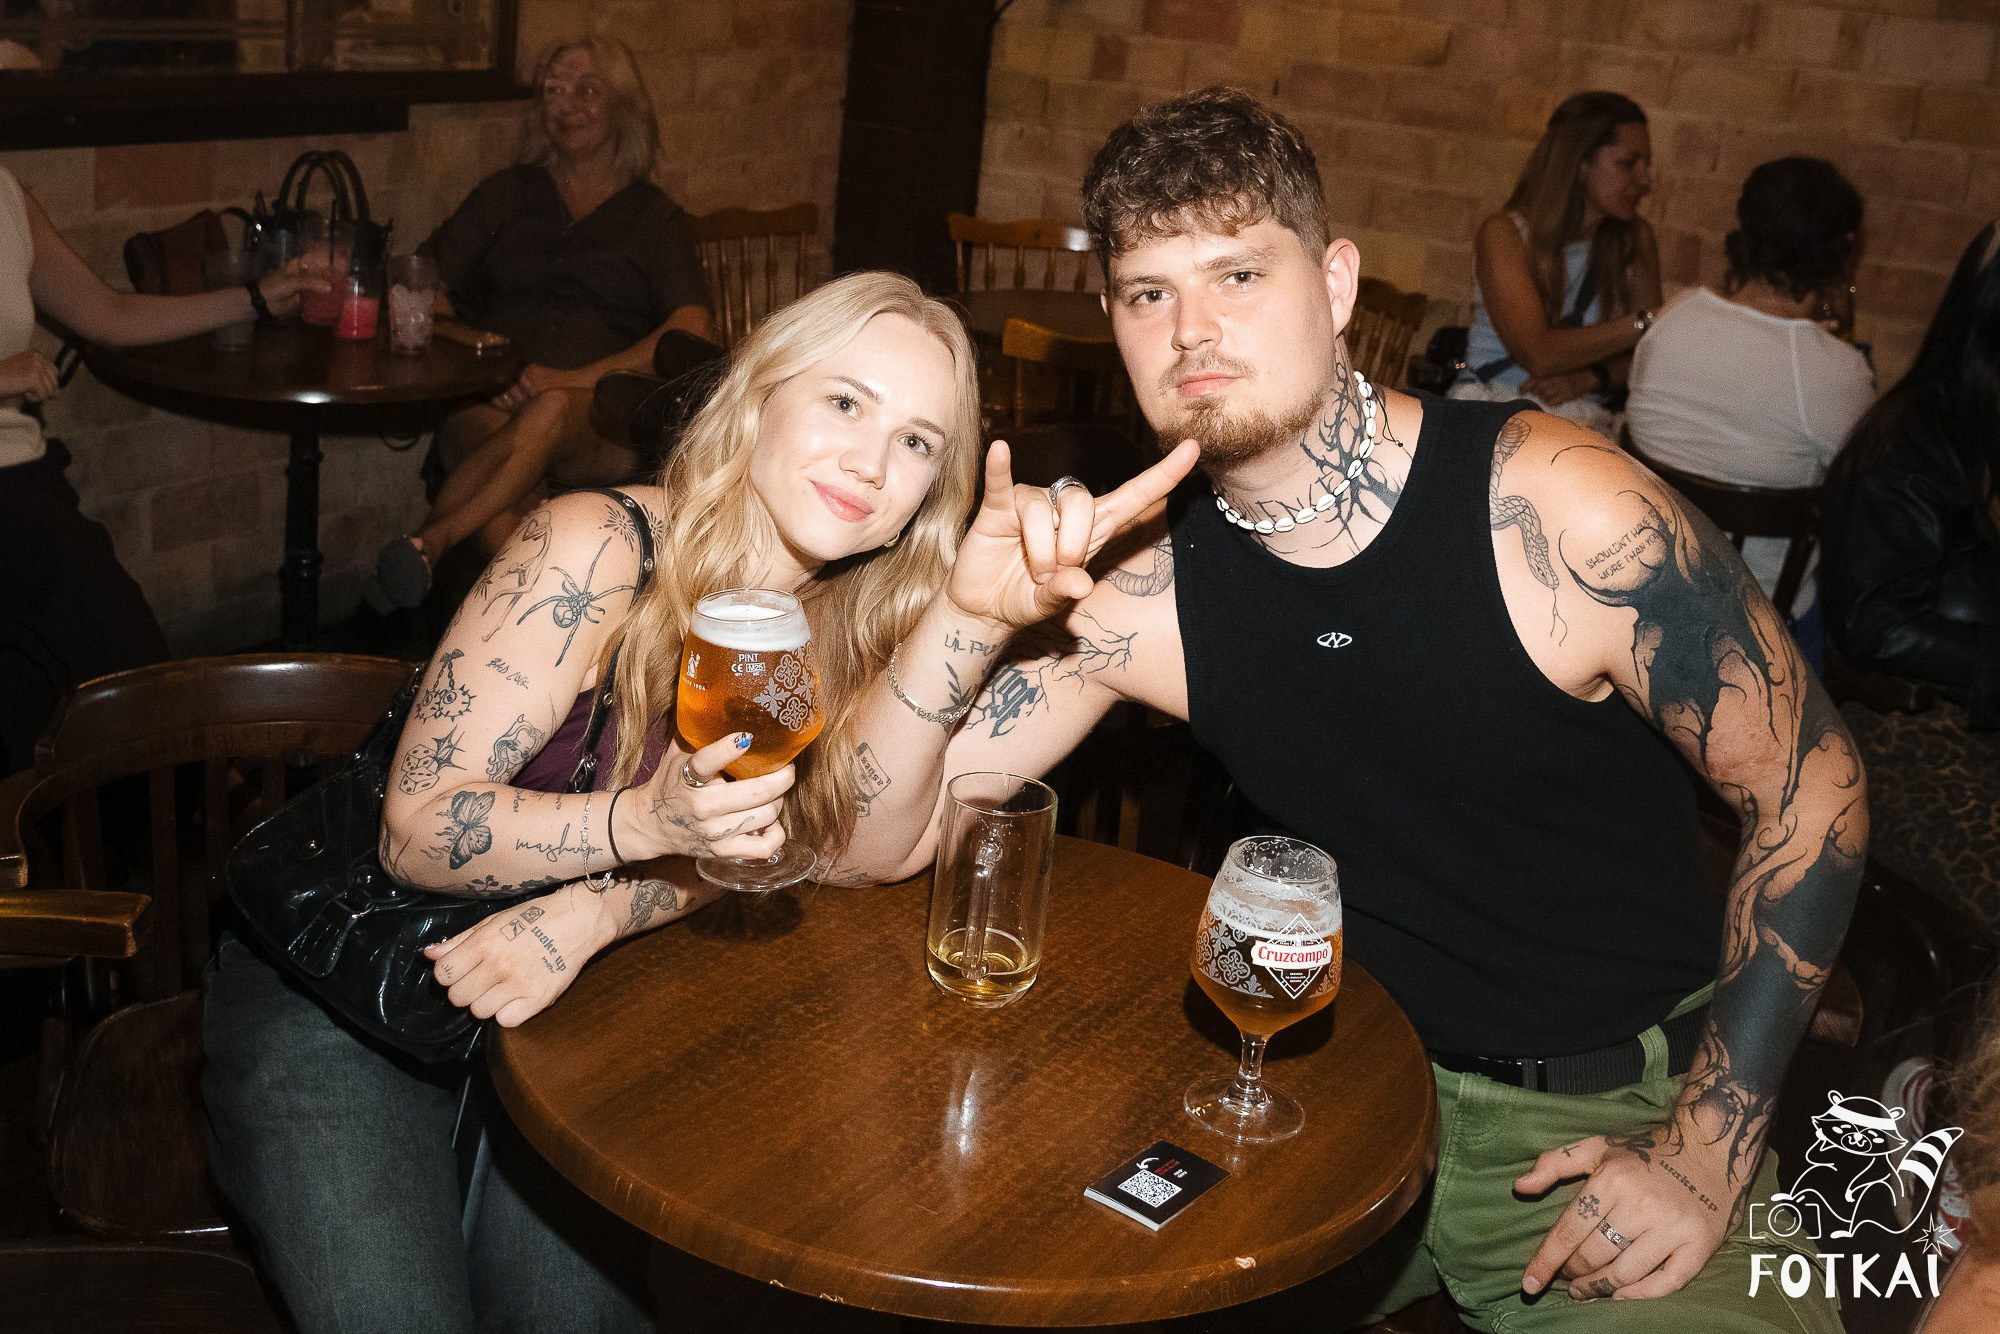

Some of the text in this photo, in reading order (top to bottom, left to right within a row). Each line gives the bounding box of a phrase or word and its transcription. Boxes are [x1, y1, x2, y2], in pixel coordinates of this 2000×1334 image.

[1585, 532, 1632, 570] SHOULDN'T
[1597, 560, 1625, 581] MORE
[1624, 543, 1646, 564] THAN
[738, 653, 758, 662] PINT
[731, 663, 744, 673] CE
[530, 926, 567, 972] wake up
[1258, 945, 1328, 964] Cruzcampo
[1698, 1193, 1719, 1212] up
